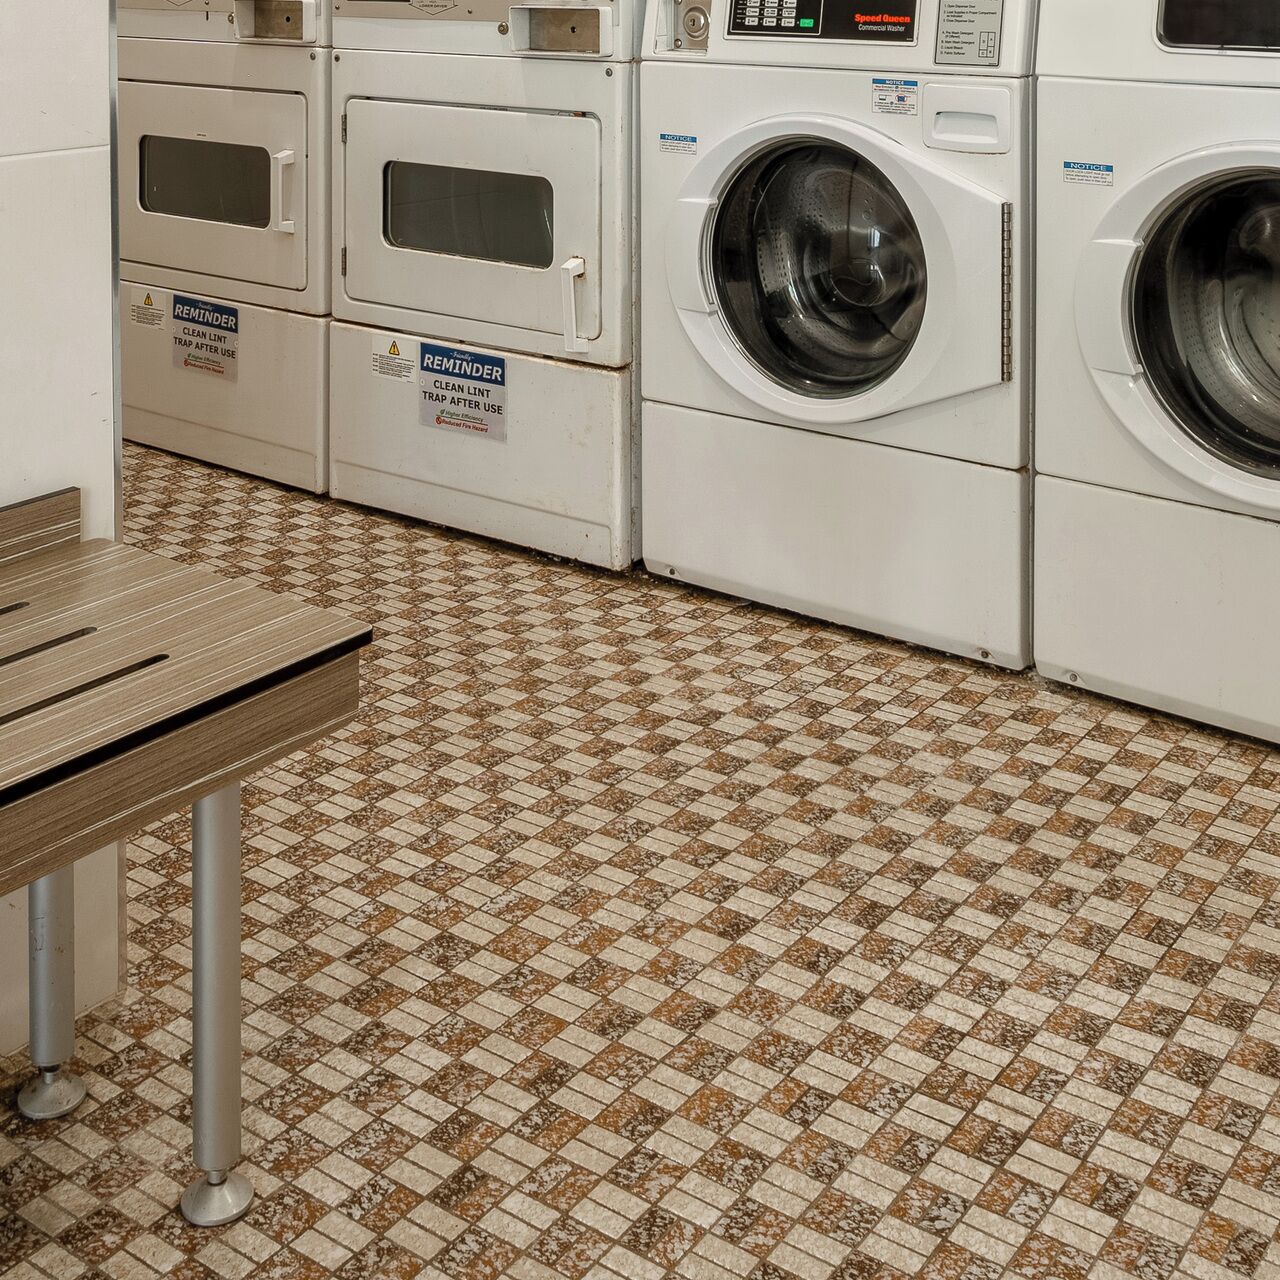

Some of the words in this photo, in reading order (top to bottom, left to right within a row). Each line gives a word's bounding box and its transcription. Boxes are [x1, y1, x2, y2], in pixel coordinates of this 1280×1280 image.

[855, 14, 881, 23] Speed
[175, 304, 235, 329] REMINDER
[183, 327, 206, 339] CLEAN
[209, 333, 227, 344] LINT
[174, 336, 192, 348] TRAP
[195, 342, 219, 354] AFTER
[221, 349, 236, 359] USE
[424, 354, 502, 381] REMINDER
[434, 380, 464, 393] CLEAN
[468, 387, 490, 398] LINT
[422, 391, 446, 403] TRAP
[450, 396, 480, 410] AFTER
[484, 403, 502, 415] USE
[442, 418, 461, 428] Reduced
[472, 424, 488, 432] Hazard
[445, 410, 460, 418] Higher
[461, 413, 483, 422] Efficiency
